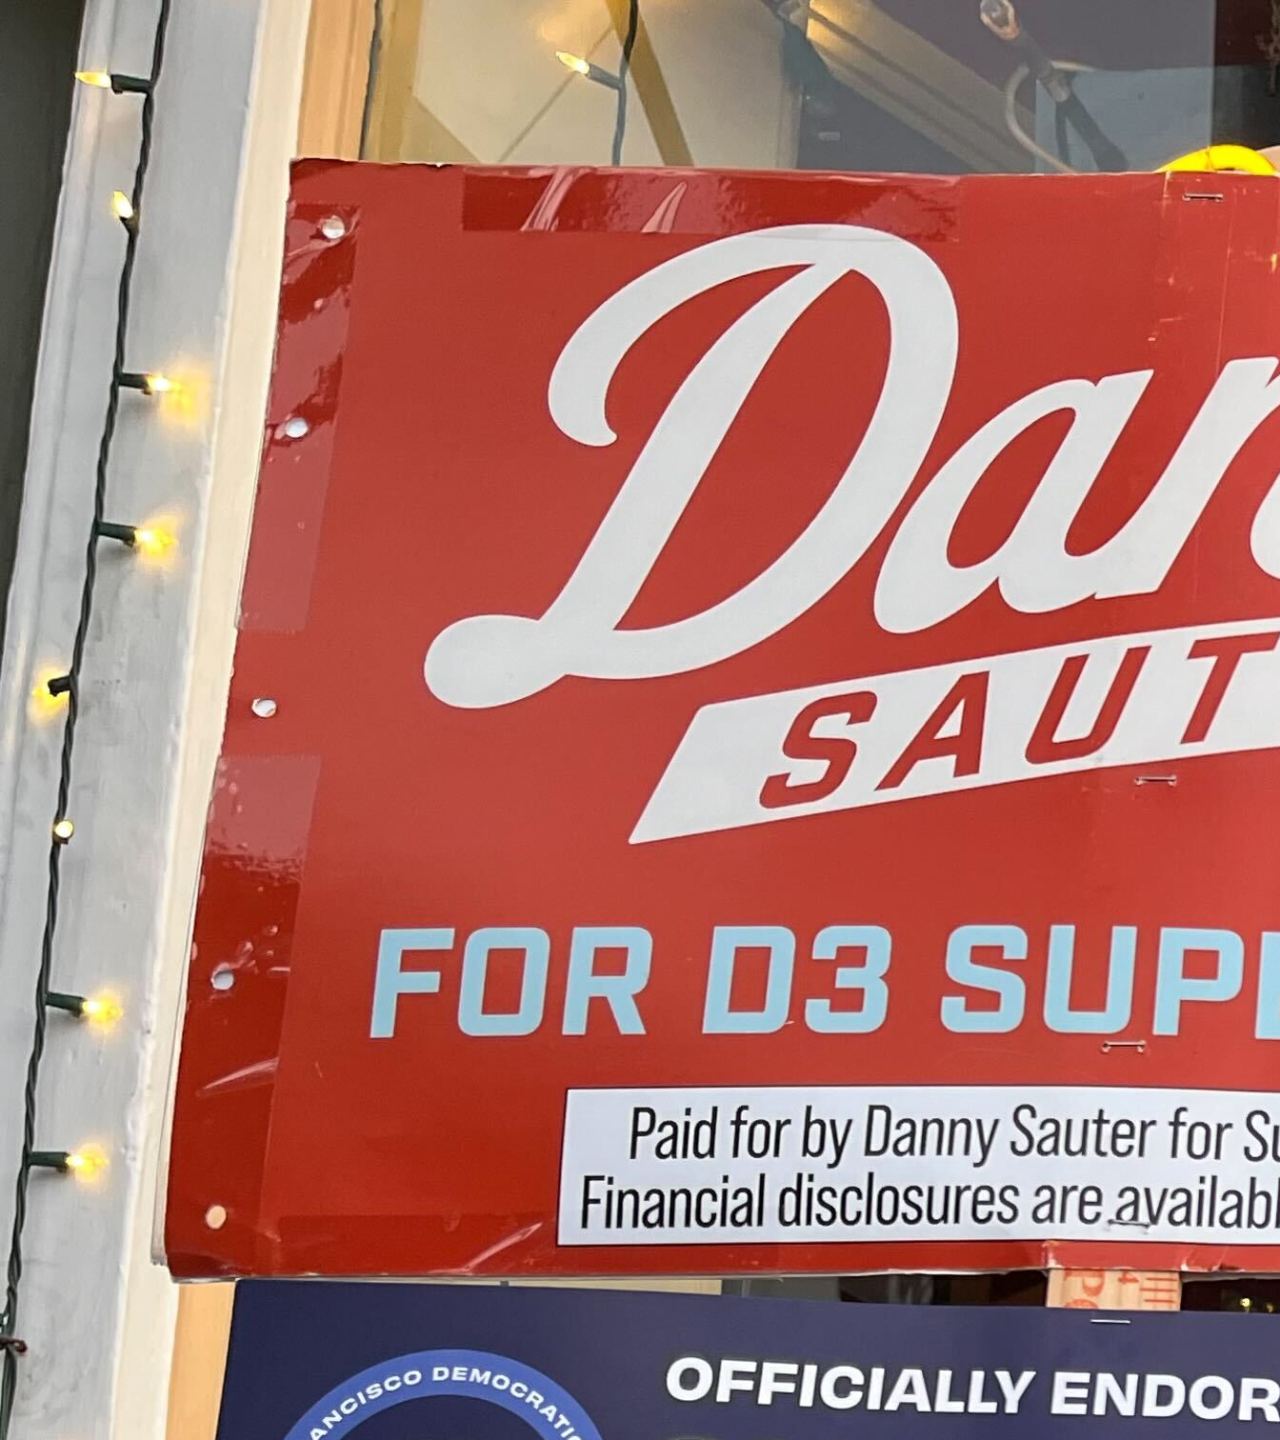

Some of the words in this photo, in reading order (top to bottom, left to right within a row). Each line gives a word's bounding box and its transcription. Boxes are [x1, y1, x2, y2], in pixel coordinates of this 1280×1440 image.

[370, 925, 652, 1040] FOR
[701, 925, 891, 1035] D3
[629, 1107, 717, 1160] Paid
[731, 1105, 791, 1159] for
[802, 1105, 851, 1168] by
[864, 1104, 999, 1167] Danny
[1010, 1103, 1156, 1158] Sauter
[1168, 1107, 1233, 1160] for
[580, 1173, 766, 1229] Financial
[778, 1172, 1020, 1227] disclosures
[1031, 1184, 1102, 1225] are
[665, 1357, 1037, 1415] OFFICIALLY
